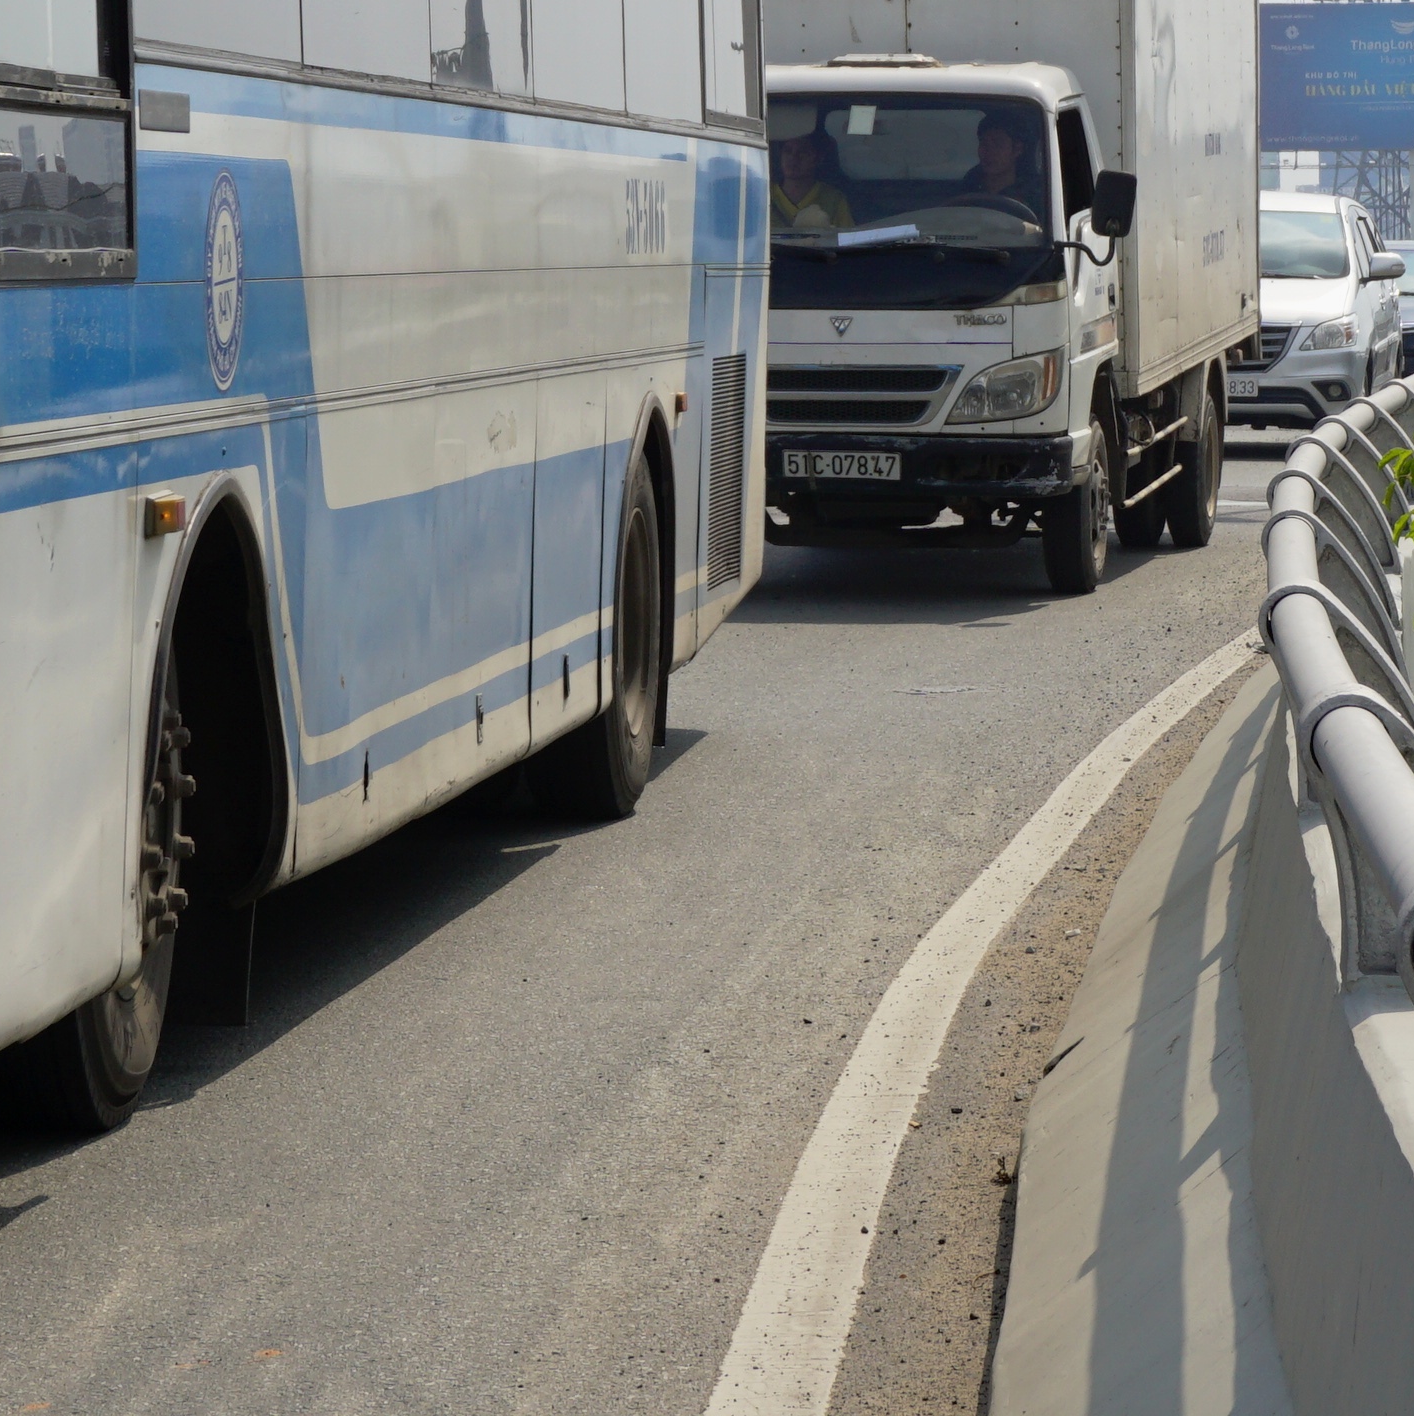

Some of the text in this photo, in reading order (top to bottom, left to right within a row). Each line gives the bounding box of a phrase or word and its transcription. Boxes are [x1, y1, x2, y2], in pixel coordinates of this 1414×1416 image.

[953, 313, 1007, 326] THACO
[1227, 380, 1255, 395] 8.33
[787, 454, 897, 477] 51C-078.47
